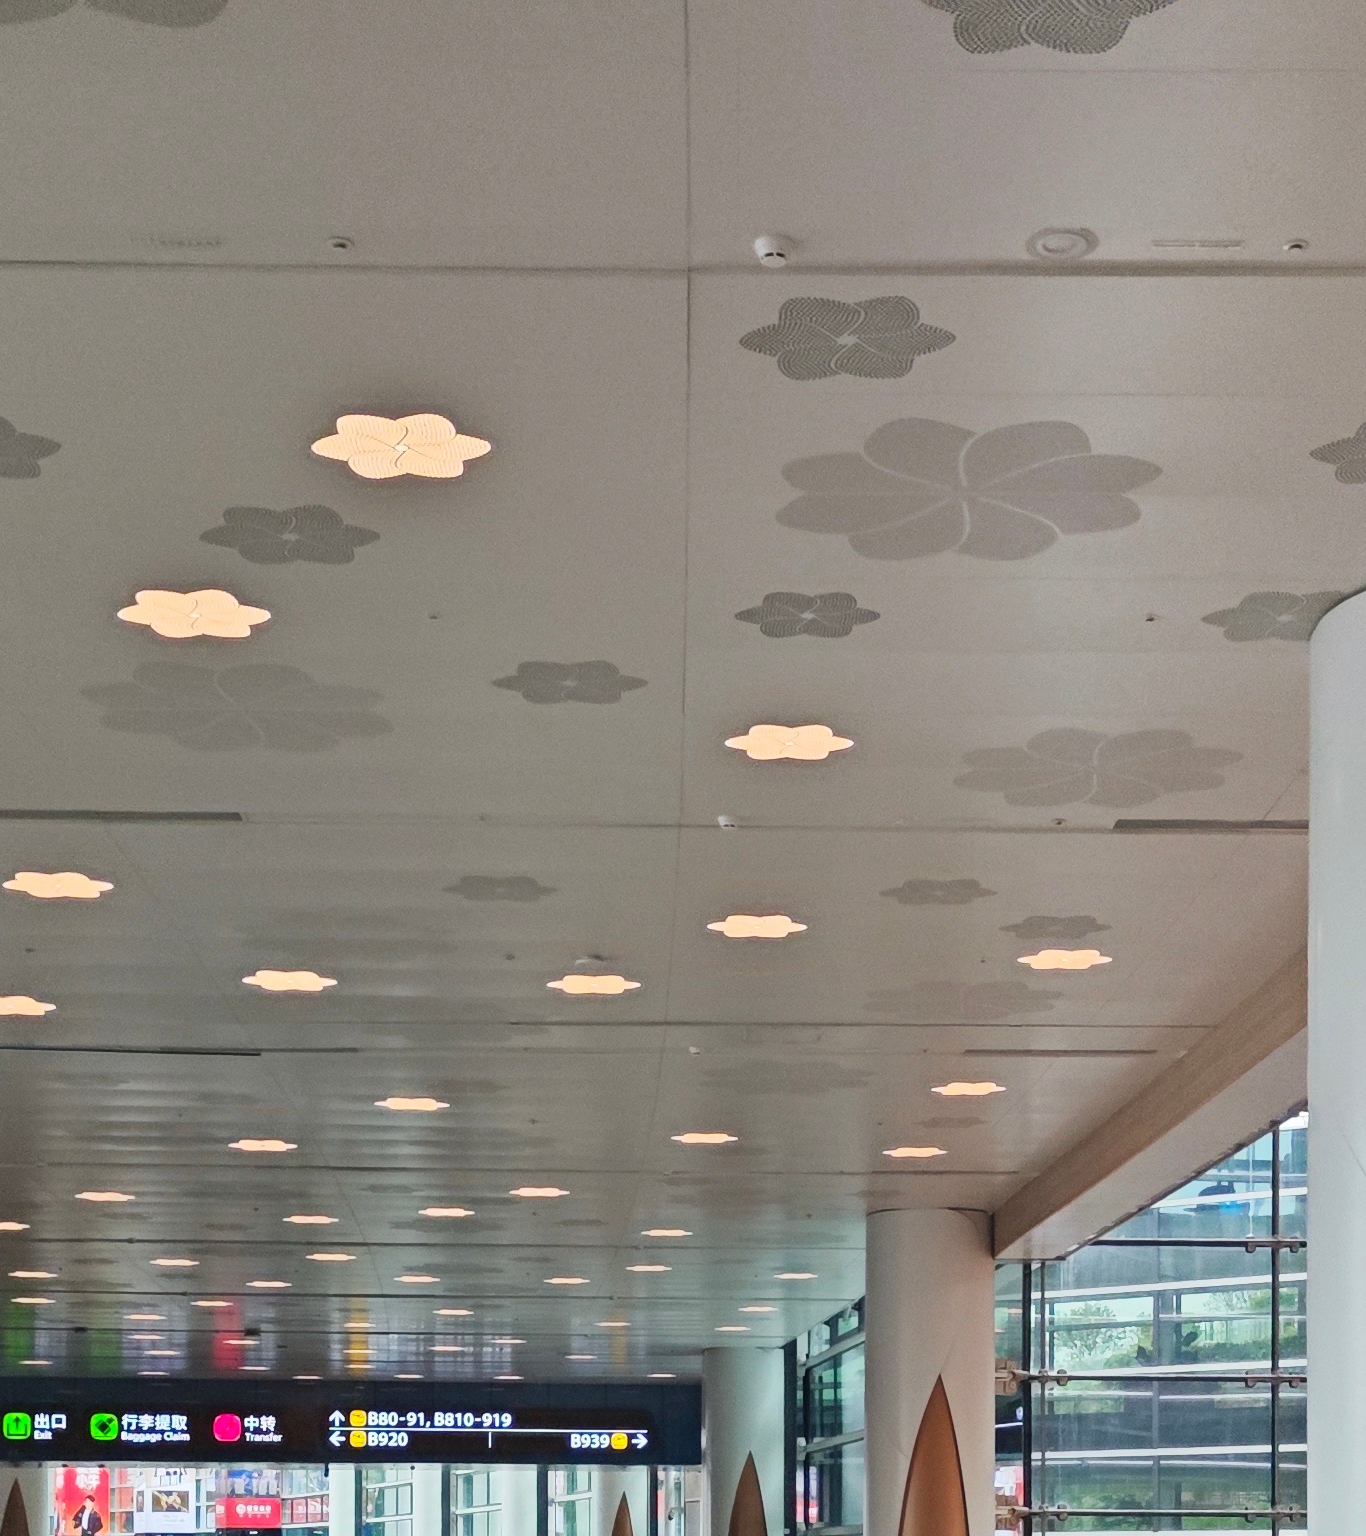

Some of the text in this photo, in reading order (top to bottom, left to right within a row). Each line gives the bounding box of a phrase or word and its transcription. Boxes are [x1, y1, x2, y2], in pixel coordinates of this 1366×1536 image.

[33, 1412, 67, 1430] 出口
[121, 1413, 188, 1431] 行李提取
[243, 1414, 277, 1431] 中转
[367, 1410, 513, 1428] B80-91, B810-919
[33, 1429, 53, 1440] Exit
[120, 1430, 191, 1443] Baggage Claim
[244, 1431, 284, 1442] Transfer
[367, 1431, 409, 1447] B920
[569, 1432, 610, 1449] B939
